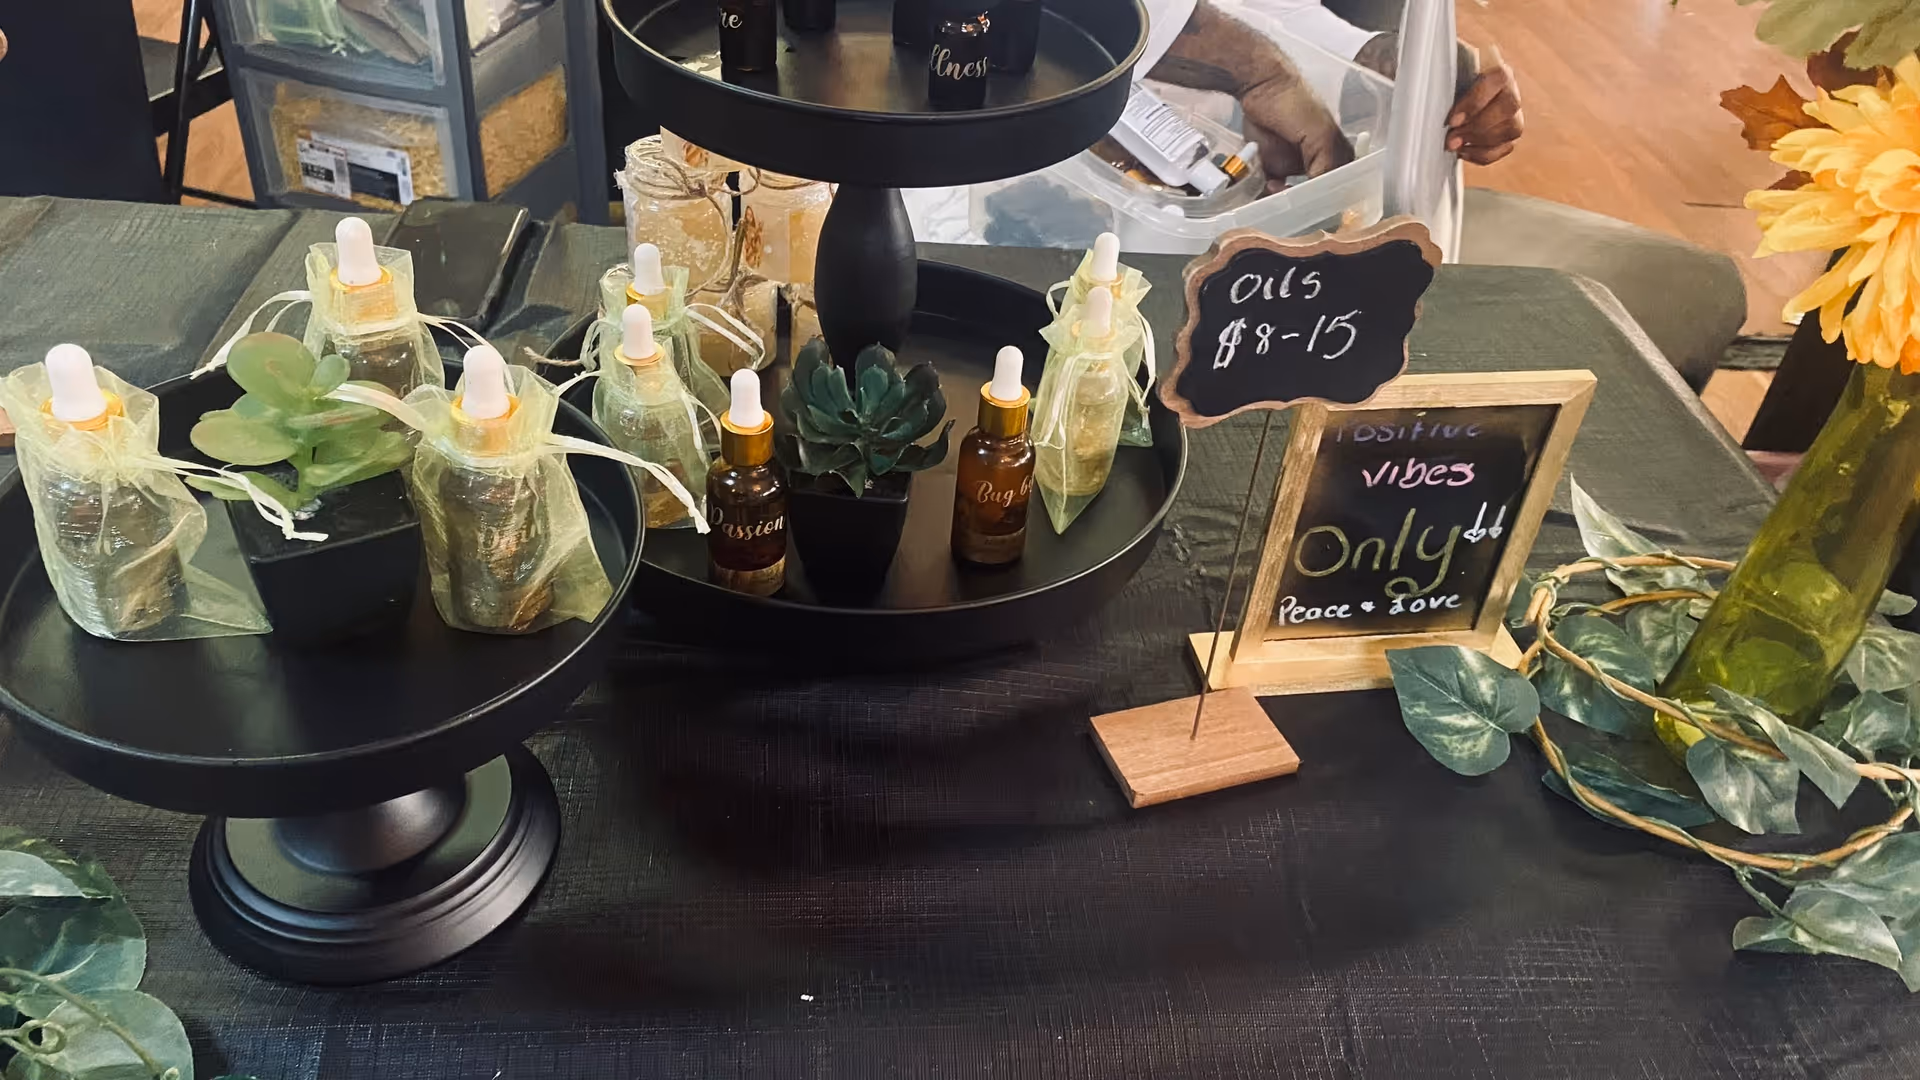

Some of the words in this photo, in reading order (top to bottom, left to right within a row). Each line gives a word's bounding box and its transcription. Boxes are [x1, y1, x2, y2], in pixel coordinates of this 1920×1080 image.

[976, 480, 1016, 508] Bug
[709, 503, 785, 541] Passion
[1294, 507, 1462, 600] Only
[1278, 595, 1353, 627] Peace
[1388, 593, 1463, 616] Love
